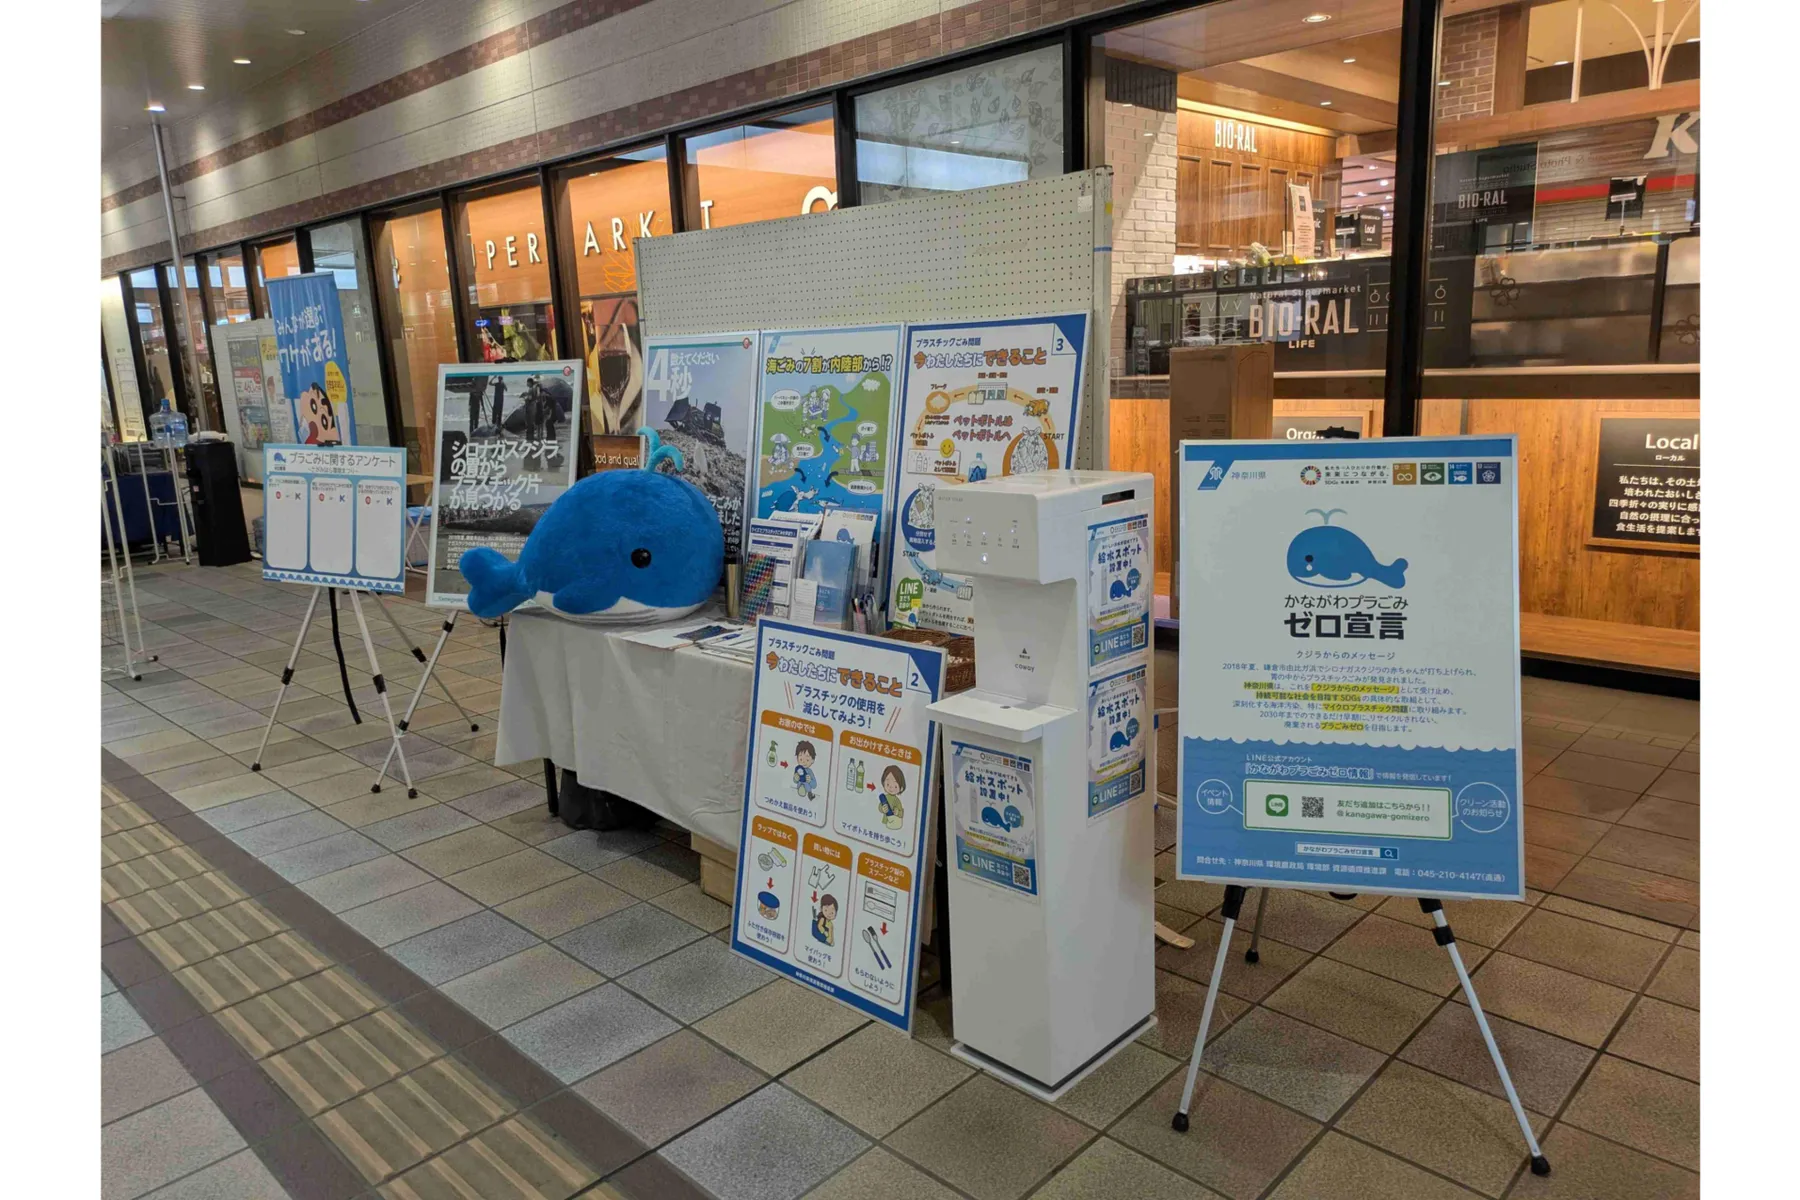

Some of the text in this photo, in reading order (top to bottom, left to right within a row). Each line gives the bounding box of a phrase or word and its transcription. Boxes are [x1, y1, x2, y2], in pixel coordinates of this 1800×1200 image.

[1215, 119, 1258, 153] BIO-RAL
[1458, 189, 1508, 209] BIO-RAL
[1249, 283, 1362, 300] Natural Supermarket
[1248, 299, 1359, 339] BIO-RAL
[916, 336, 981, 348] プラスチックごみ問題
[1056, 338, 1064, 352] 3
[1288, 339, 1316, 349] LIFE
[913, 346, 1048, 370] 今わたしたちにできること
[1043, 432, 1065, 441] START
[1645, 433, 1699, 450] Local
[451, 438, 559, 462] シロナガスクジラ
[1655, 454, 1686, 462] ローカル
[289, 451, 396, 468] プラごみに関するアンケート
[450, 457, 507, 477] の胃から
[608, 453, 622, 465] and
[1230, 470, 1267, 481] 神奈川県
[1618, 475, 1700, 488] 私たちは、その土
[450, 474, 543, 495] プラスチック片
[449, 488, 522, 511] が見つかる
[1608, 498, 1700, 512] 四季折々の実りに感
[902, 550, 920, 559] START
[1098, 543, 1142, 565] 給水スポット
[900, 582, 920, 595] LINE
[1284, 593, 1410, 610] かながわプラごみ
[1283, 611, 1409, 641] ゼロ宣言
[768, 637, 836, 661] プラスチックごみ問題
[1100, 636, 1119, 654] LINE
[1296, 649, 1396, 661] クジラからのメッセージ
[766, 650, 903, 698] 今わたしたちにできること
[911, 672, 919, 687] 2
[795, 683, 886, 716] プラスチックの使用を
[1097, 692, 1140, 719] 給水スポット
[849, 735, 913, 760] お出かけするときは
[1246, 753, 1313, 763] LINE公式アカウント
[964, 770, 1024, 796] 給水スポット
[1099, 785, 1118, 803] LINE
[1200, 788, 1229, 798] イベント
[1206, 798, 1223, 807] 情報
[1459, 797, 1507, 809] クリーン活動
[1462, 807, 1503, 818] のお知らせ
[757, 823, 792, 842] ラップではなく
[971, 854, 996, 872] LINE
[854, 967, 895, 990] もらわないように
